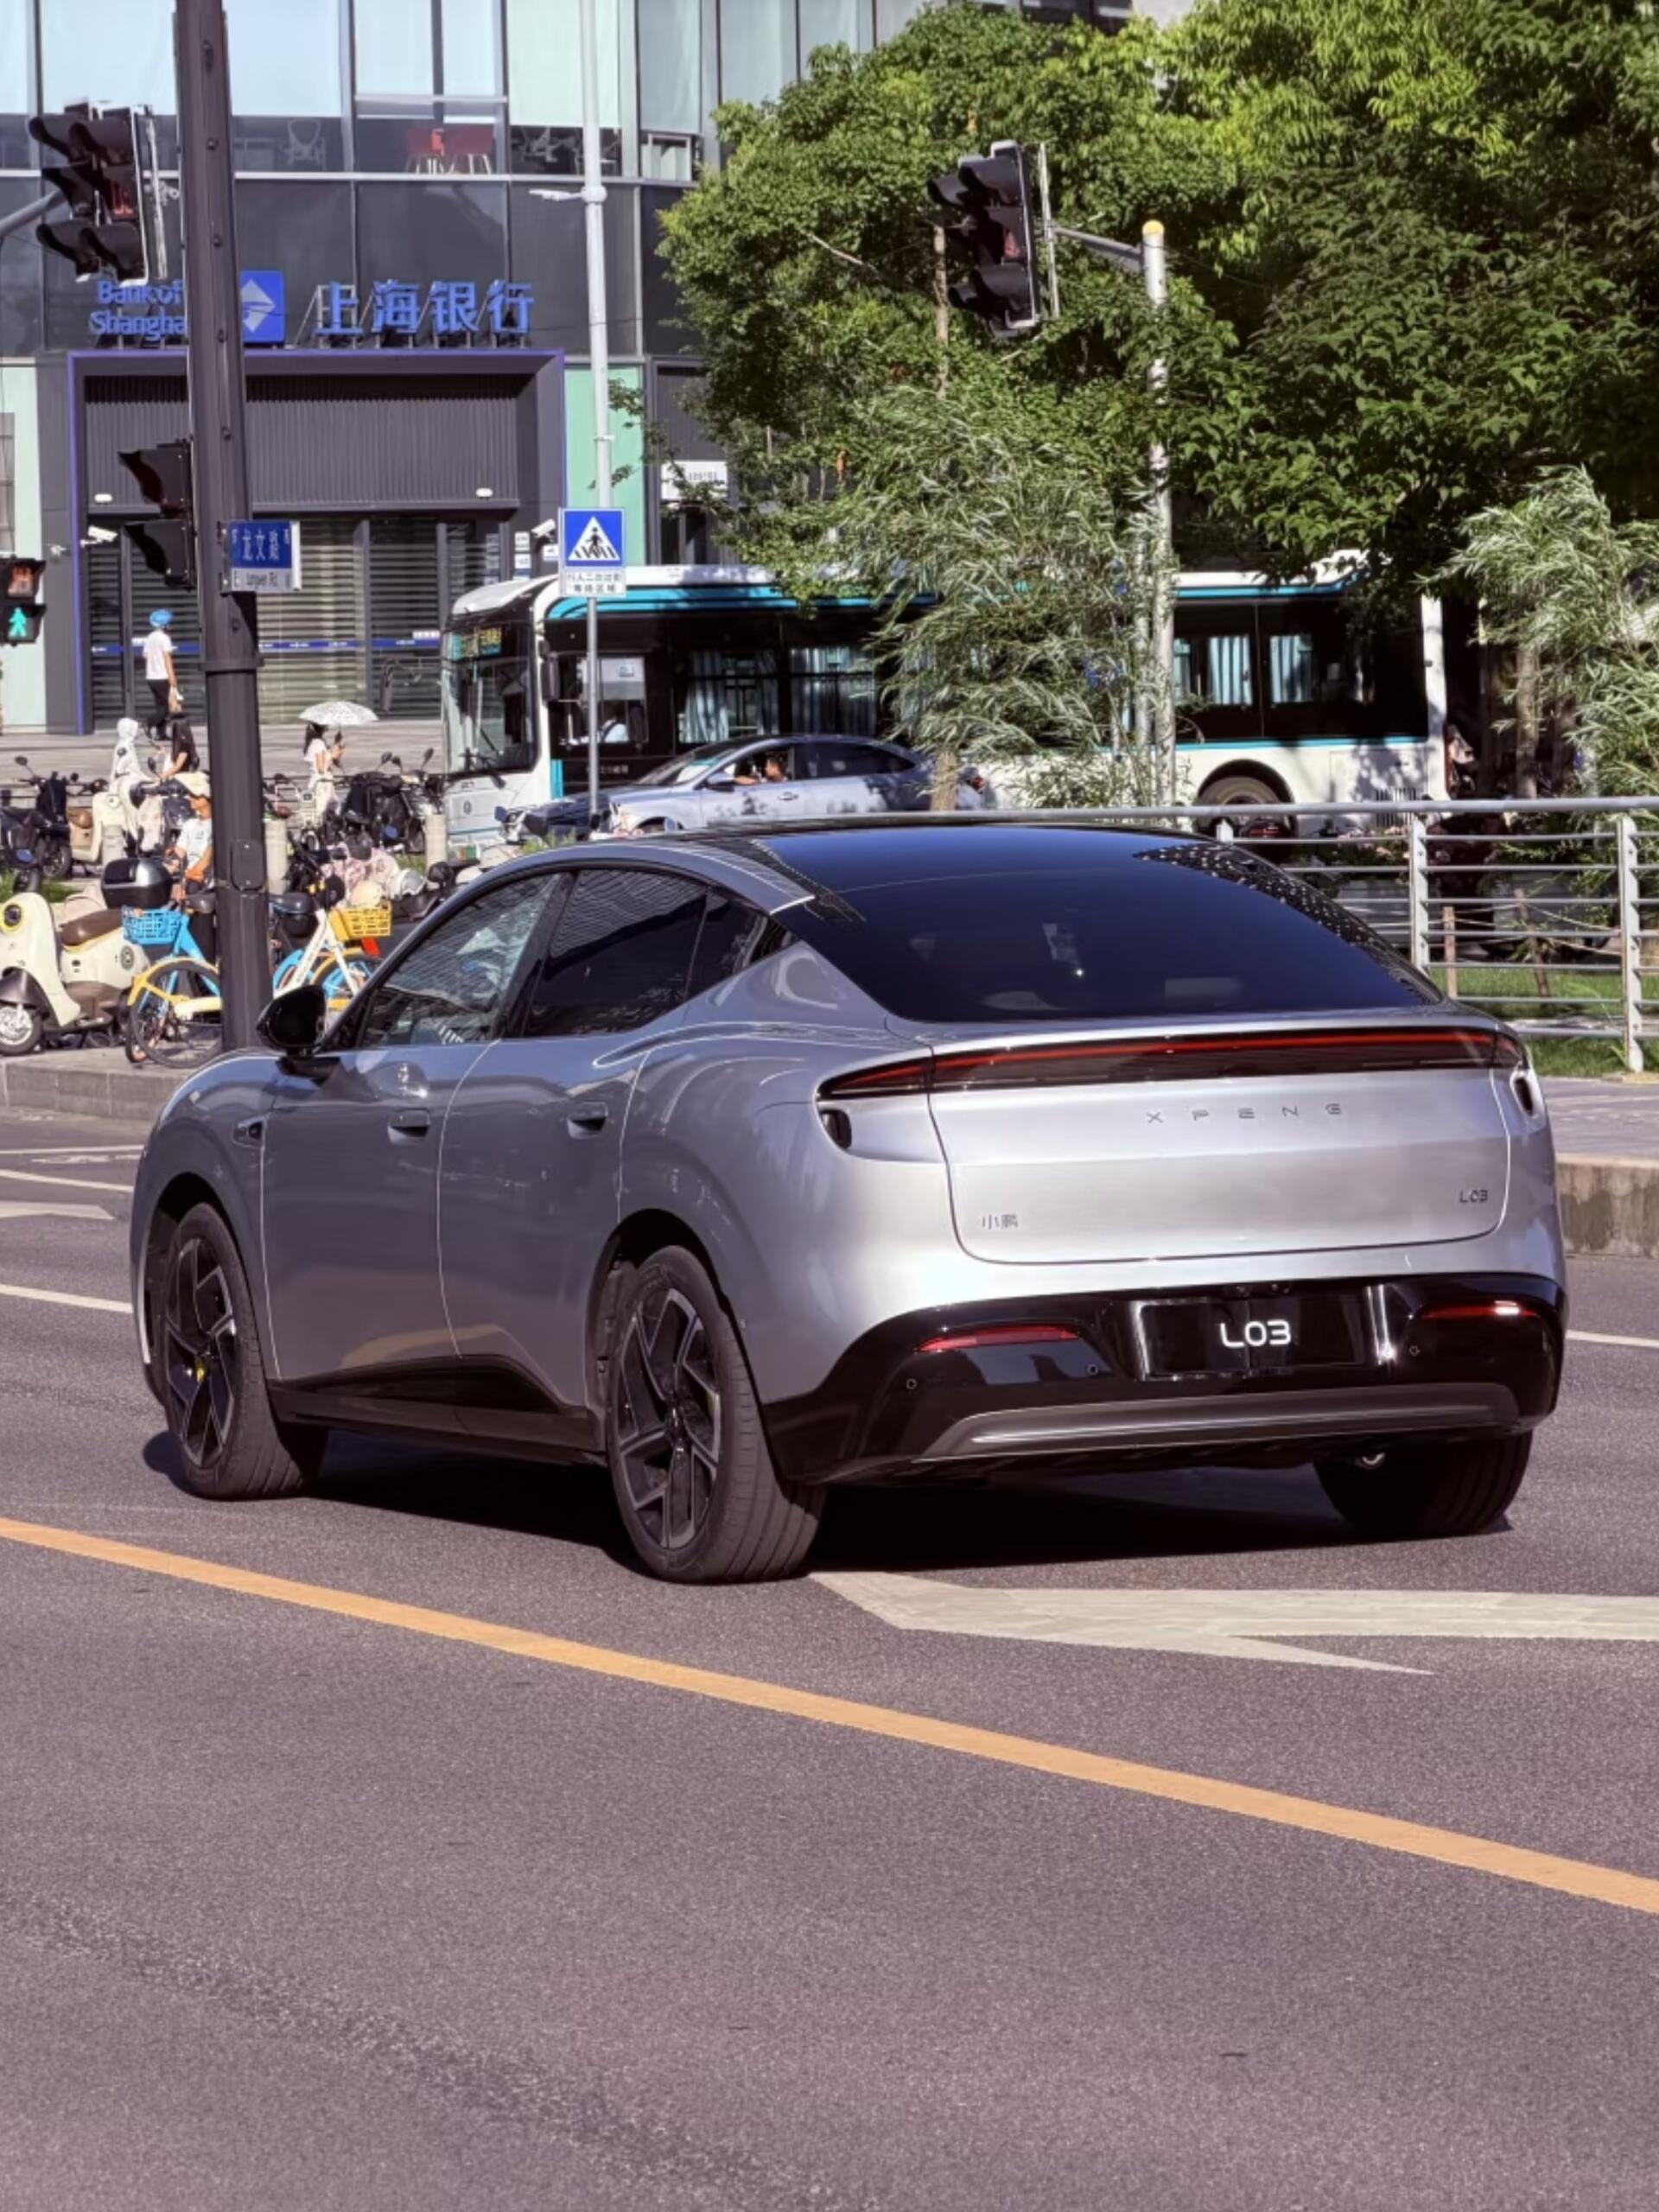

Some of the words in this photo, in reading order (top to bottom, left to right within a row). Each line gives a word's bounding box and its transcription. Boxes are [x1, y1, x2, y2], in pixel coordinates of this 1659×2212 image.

[98, 279, 153, 304] Bank
[156, 279, 182, 304] of
[314, 279, 534, 334] 上海银行
[90, 310, 186, 341] Shangha
[1147, 1103, 1342, 1123] XPENG
